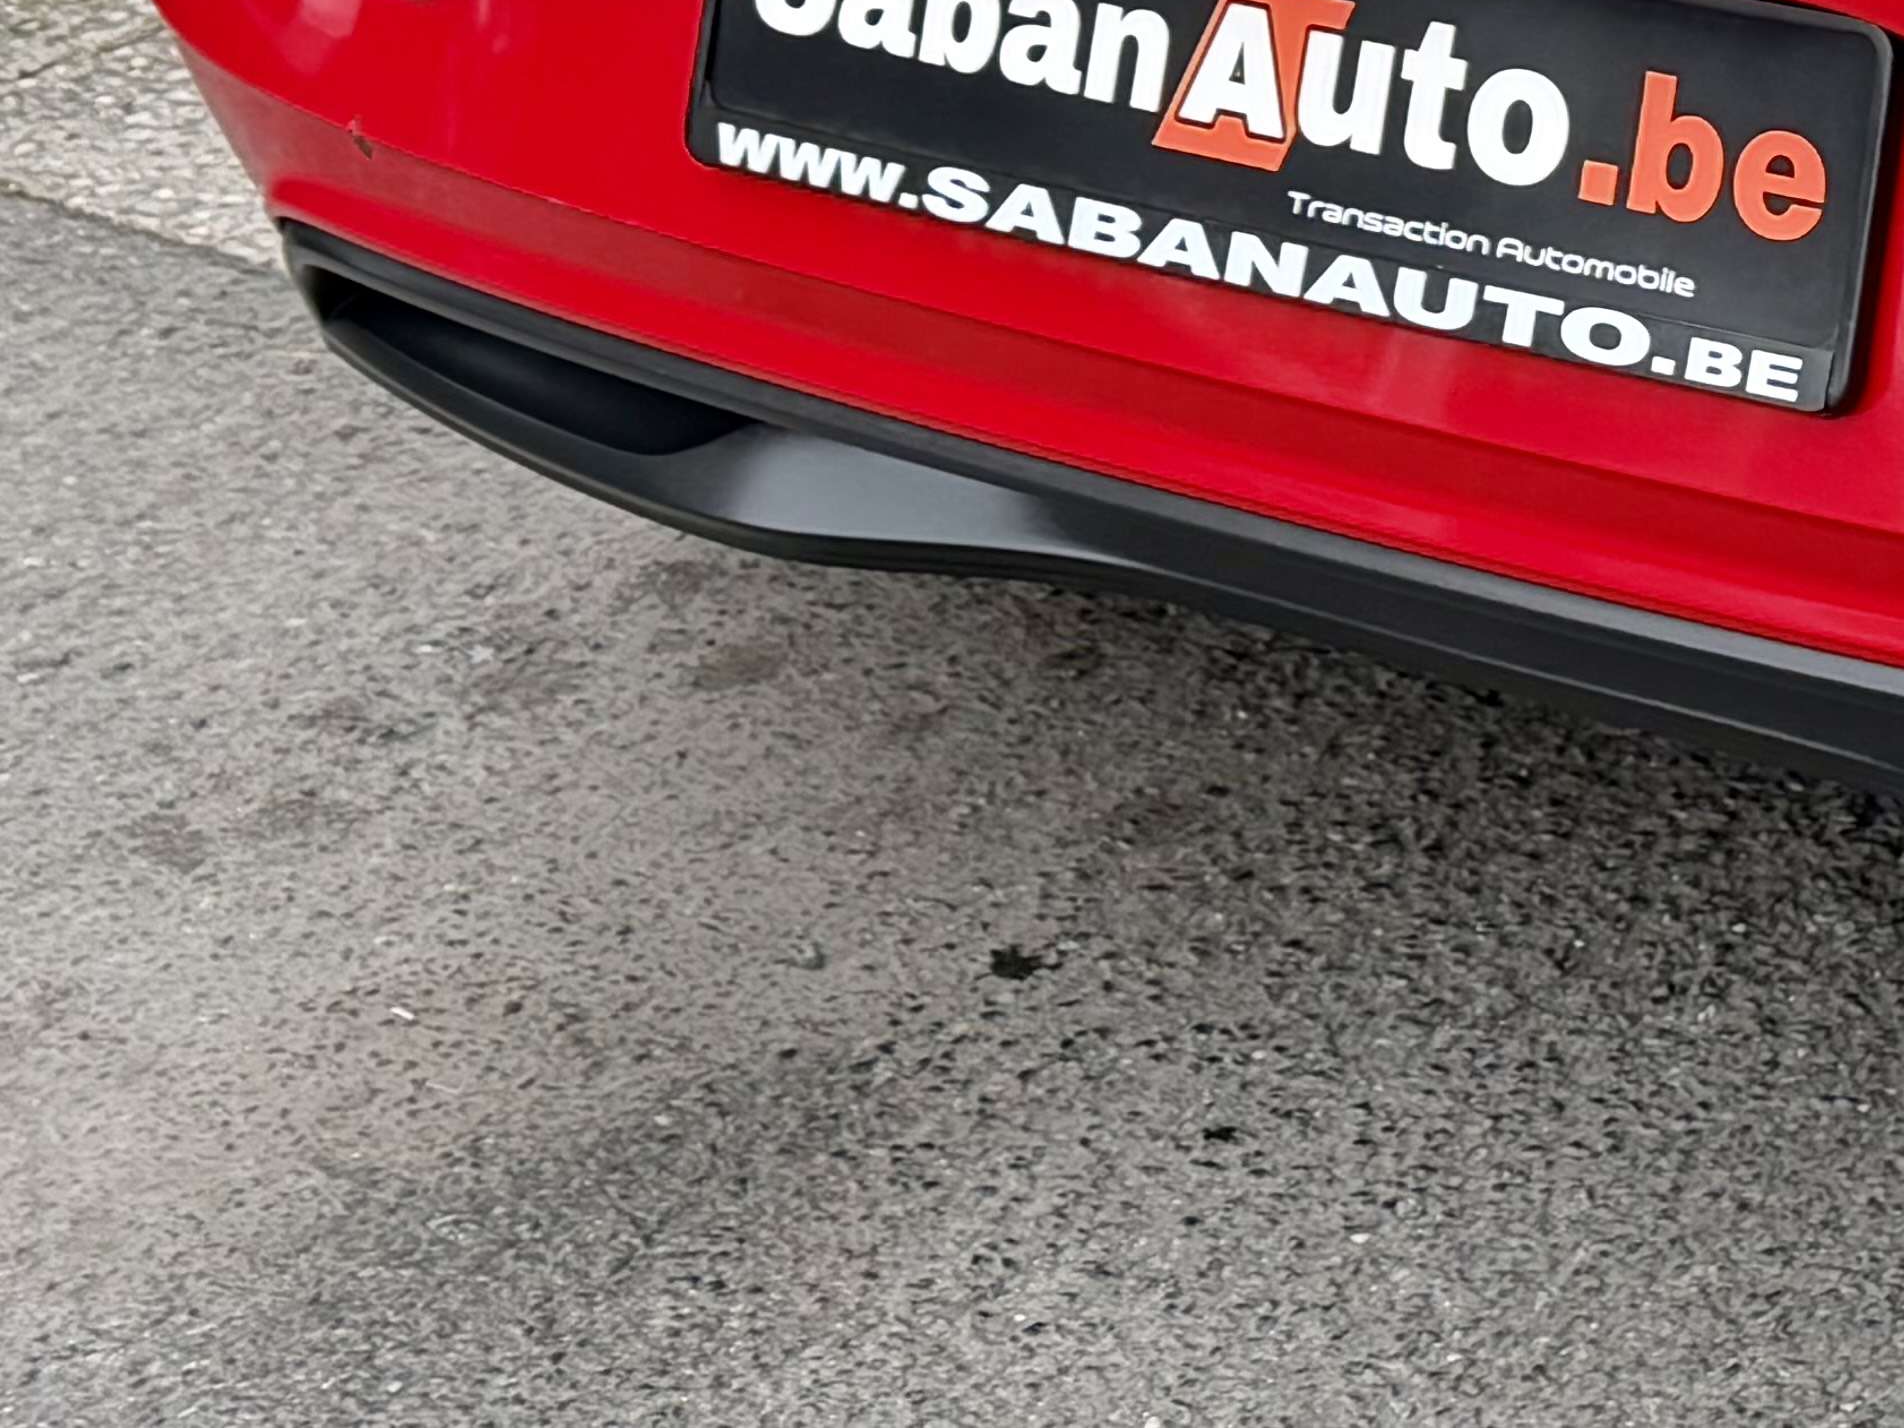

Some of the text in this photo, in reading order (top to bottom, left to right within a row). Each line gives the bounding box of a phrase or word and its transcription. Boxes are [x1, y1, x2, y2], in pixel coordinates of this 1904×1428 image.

[715, 120, 1806, 404] www.SABANAUTO.BE
[1287, 190, 1697, 300] Transaction Automobile
